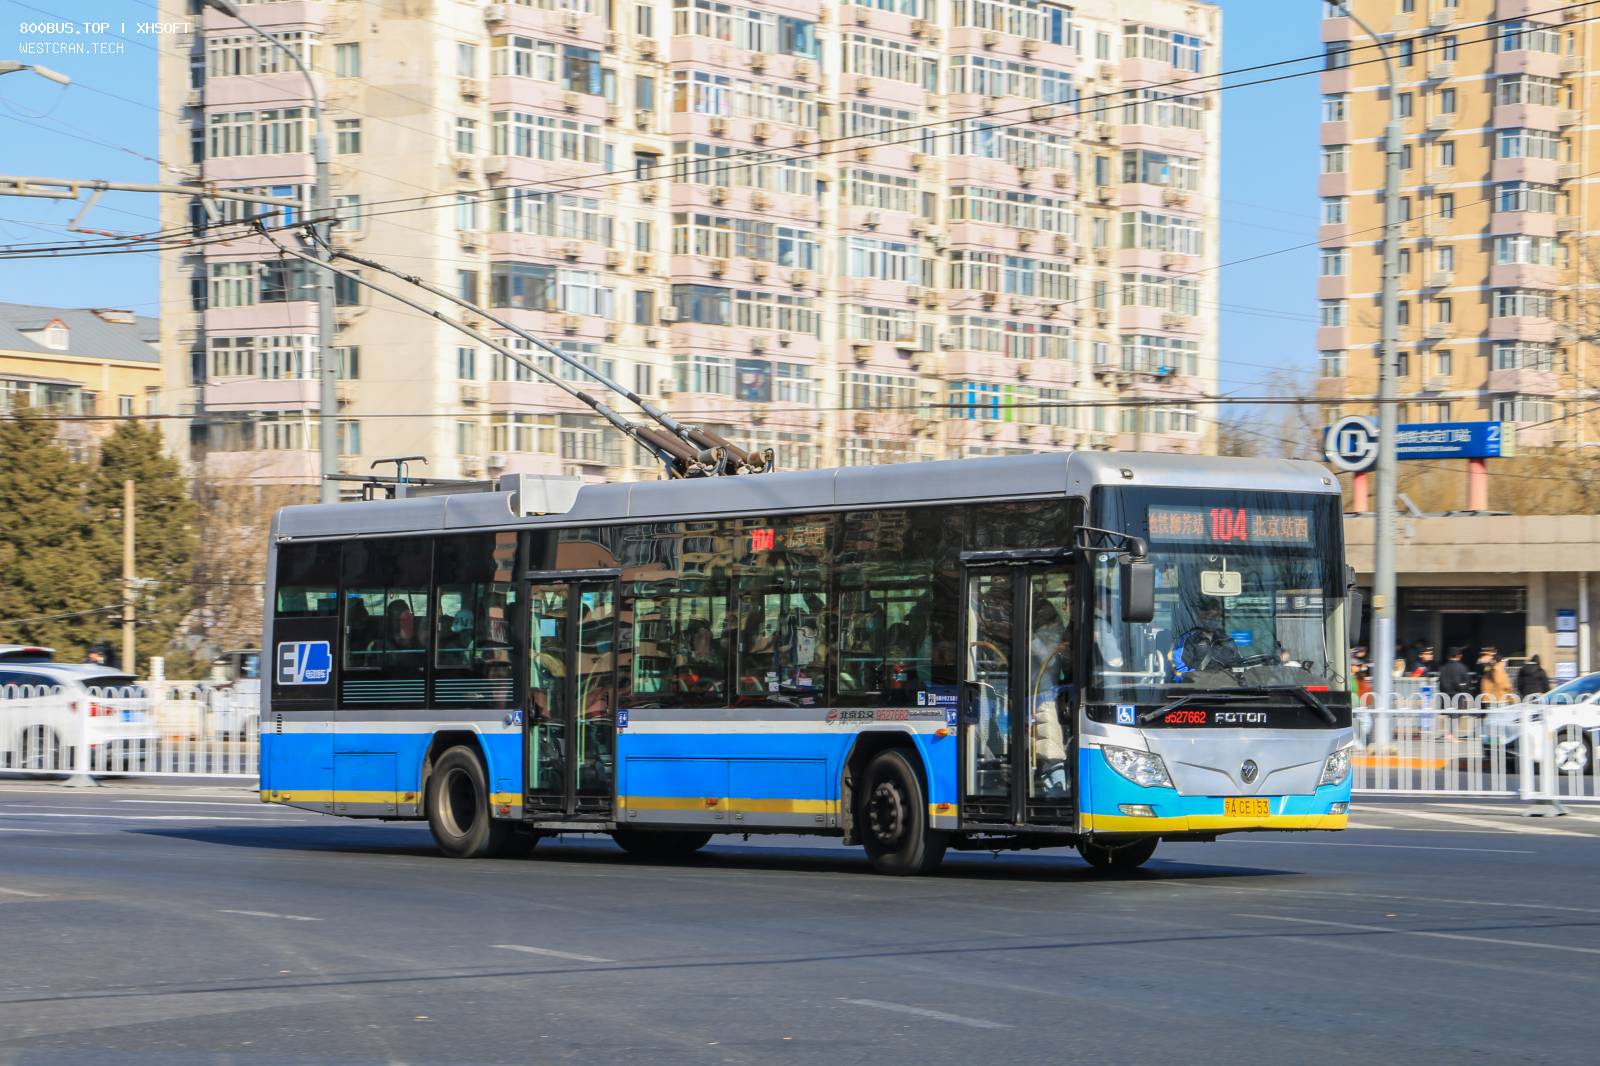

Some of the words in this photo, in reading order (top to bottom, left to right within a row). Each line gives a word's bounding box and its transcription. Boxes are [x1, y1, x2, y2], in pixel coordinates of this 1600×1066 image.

[1487, 425, 1500, 441] 2
[1209, 507, 1249, 542] 104
[839, 709, 875, 720] 北京公交
[1215, 712, 1267, 723] FOTON
